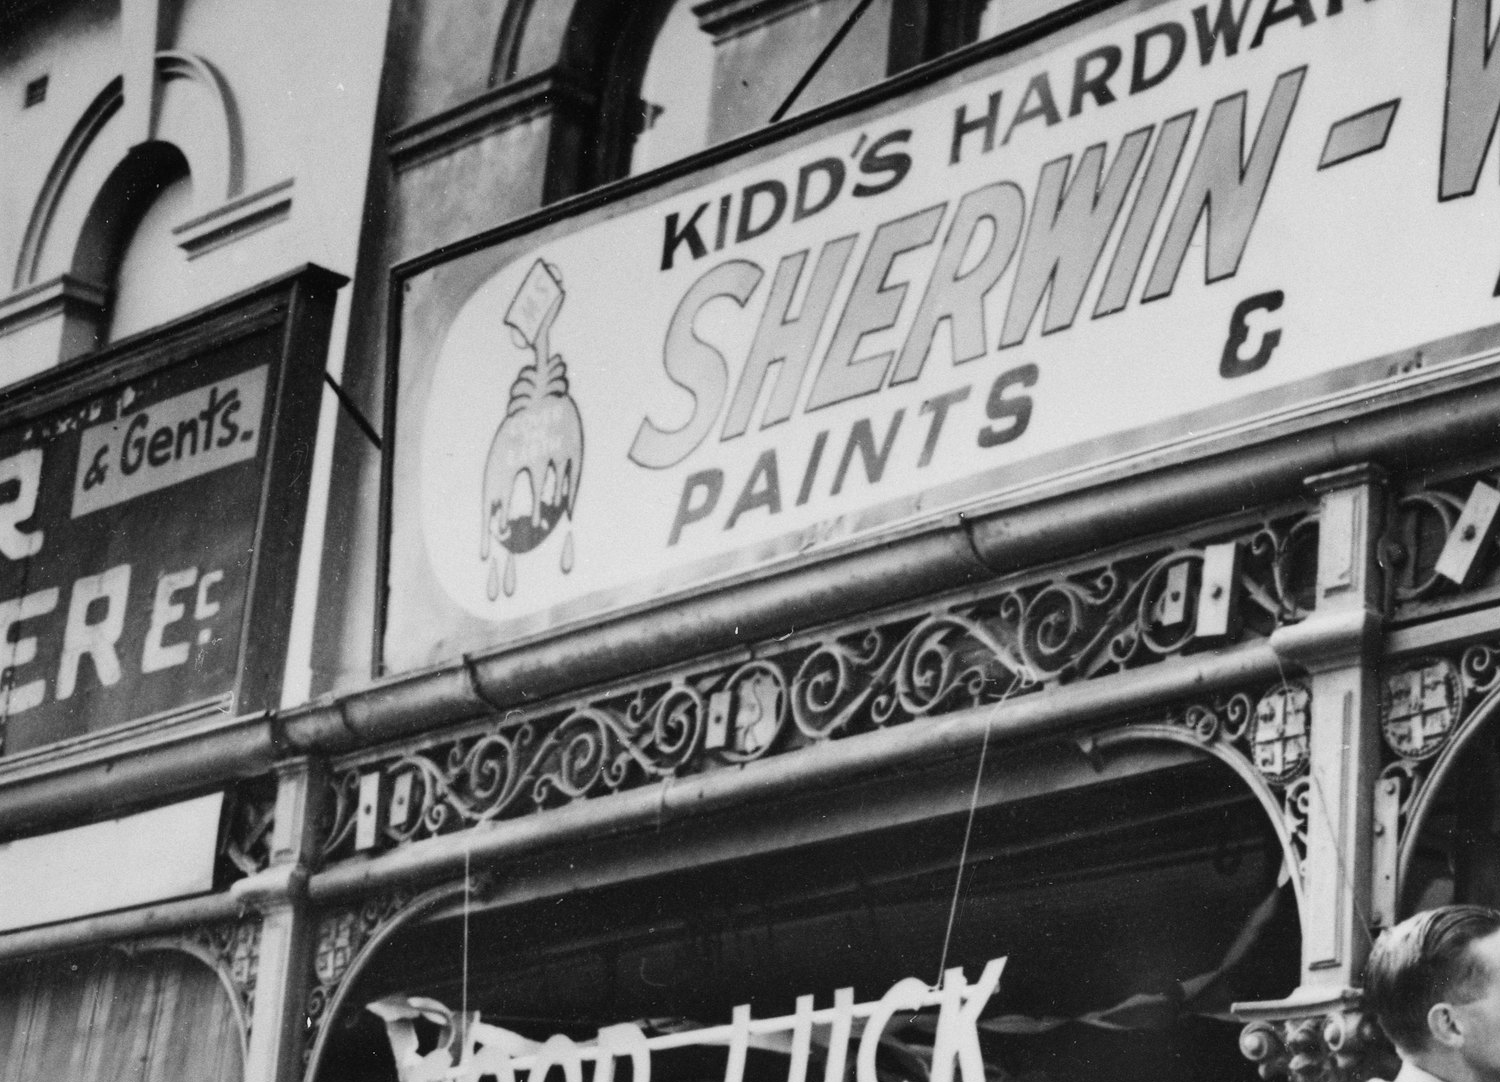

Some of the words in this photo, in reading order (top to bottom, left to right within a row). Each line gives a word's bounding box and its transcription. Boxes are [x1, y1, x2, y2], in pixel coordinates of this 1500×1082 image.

[627, 64, 1310, 470] SHERWIN
[660, 128, 913, 271] KIDD'S
[948, 0, 1372, 167] HARDWA
[82, 443, 110, 492] &
[666, 362, 1041, 547] PAINTS
[1218, 289, 1285, 380] &
